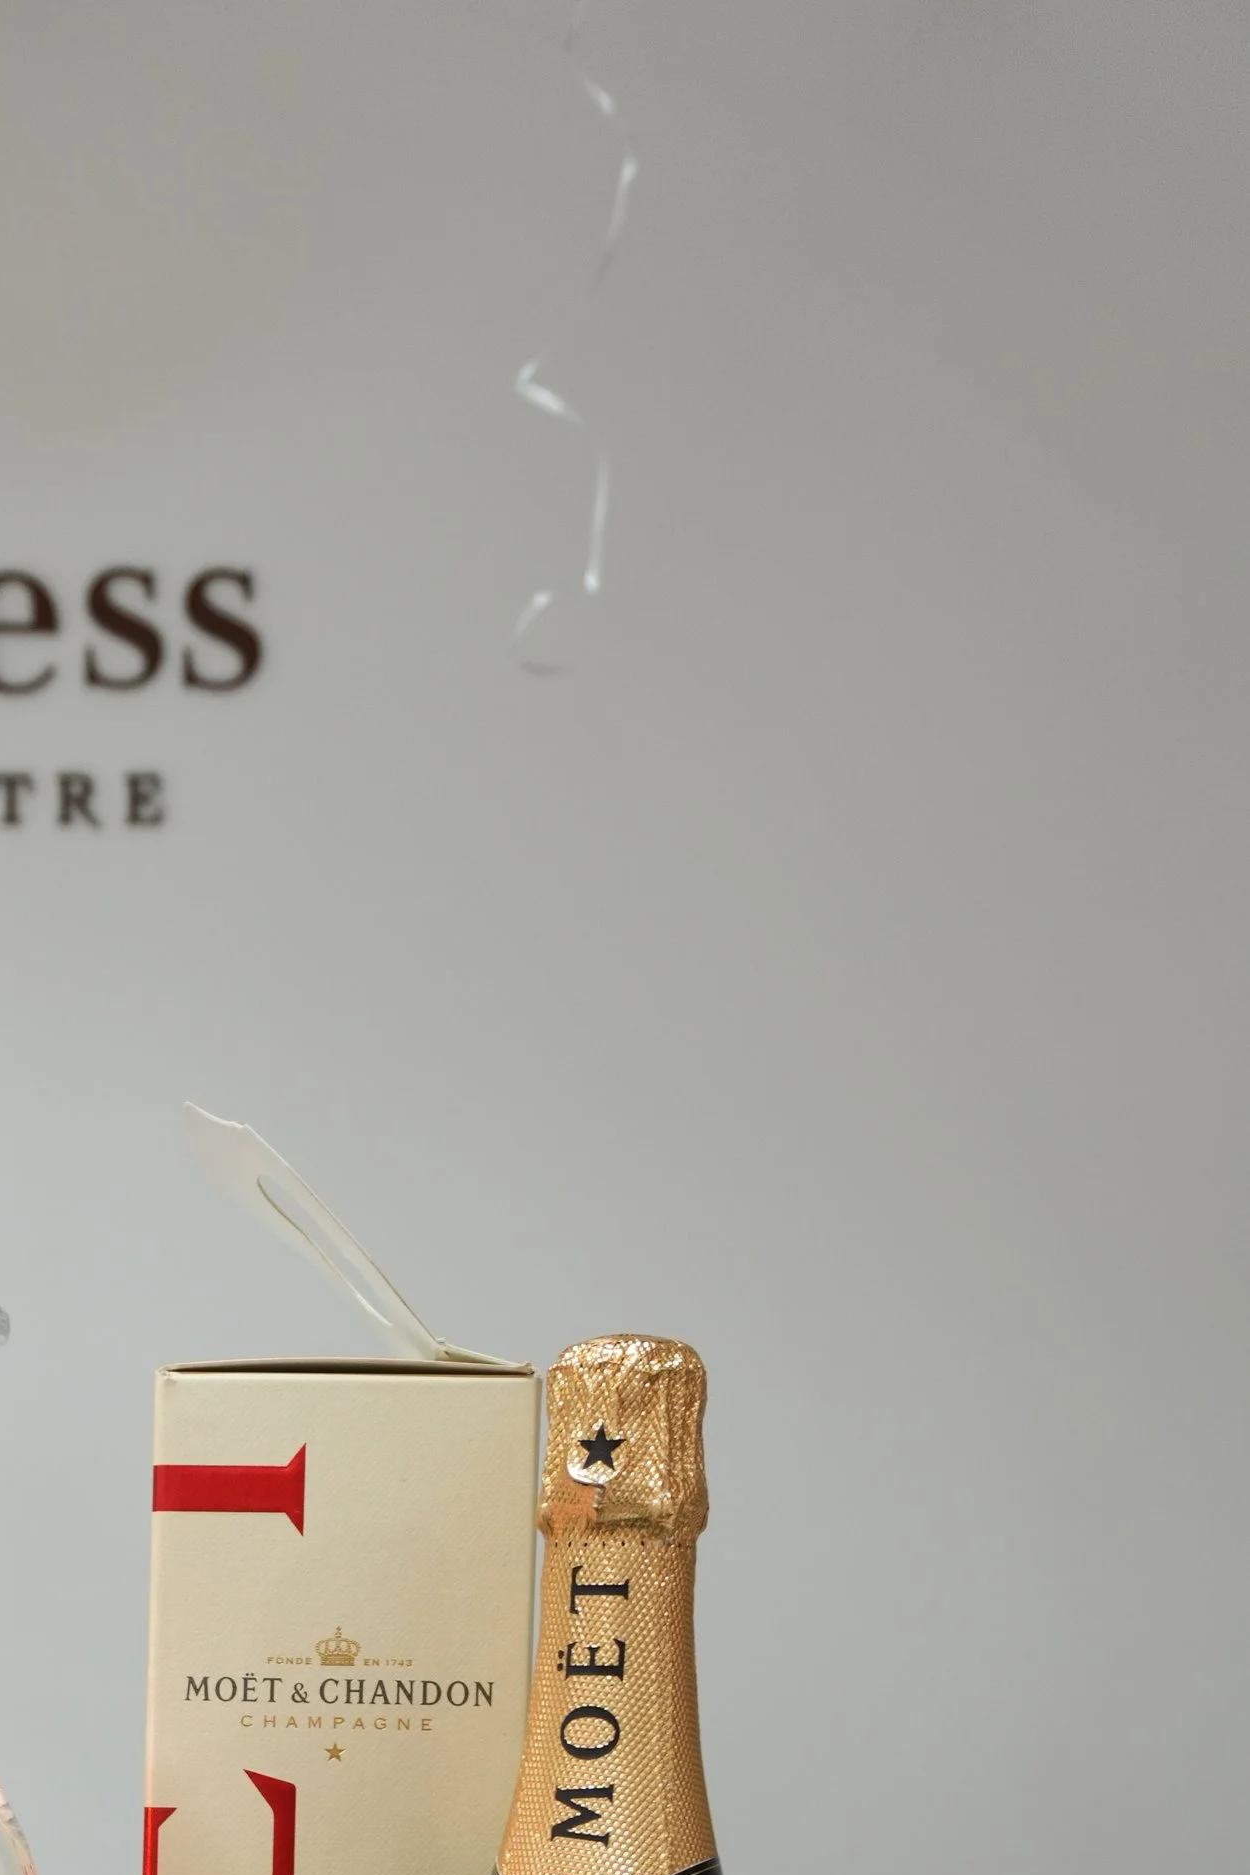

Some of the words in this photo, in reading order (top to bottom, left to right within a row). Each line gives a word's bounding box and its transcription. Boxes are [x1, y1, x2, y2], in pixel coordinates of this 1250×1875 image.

[363, 1658, 381, 1667] EN
[386, 1659, 414, 1668] 1743
[184, 1672, 283, 1703] MOËT
[291, 1681, 310, 1705] &
[319, 1677, 495, 1707] CHANDON
[550, 1564, 630, 1848] MOËT
[240, 1714, 433, 1732] CHAMPAGNE
